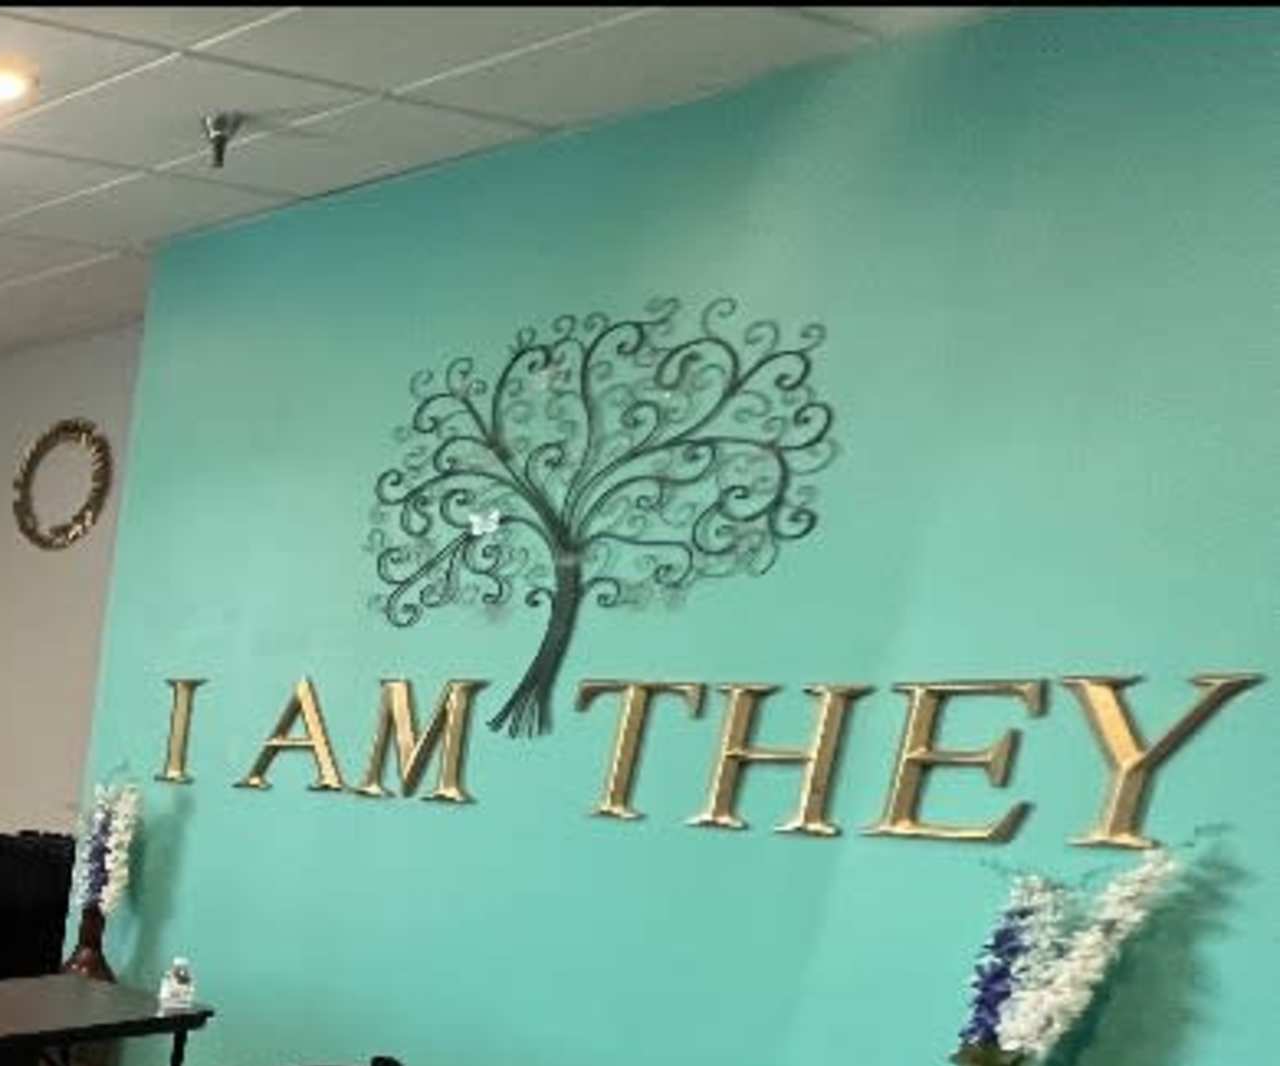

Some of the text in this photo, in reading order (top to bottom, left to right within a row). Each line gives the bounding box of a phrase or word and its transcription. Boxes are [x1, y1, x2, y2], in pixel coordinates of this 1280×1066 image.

[153, 673, 1268, 850] I AM THEY
